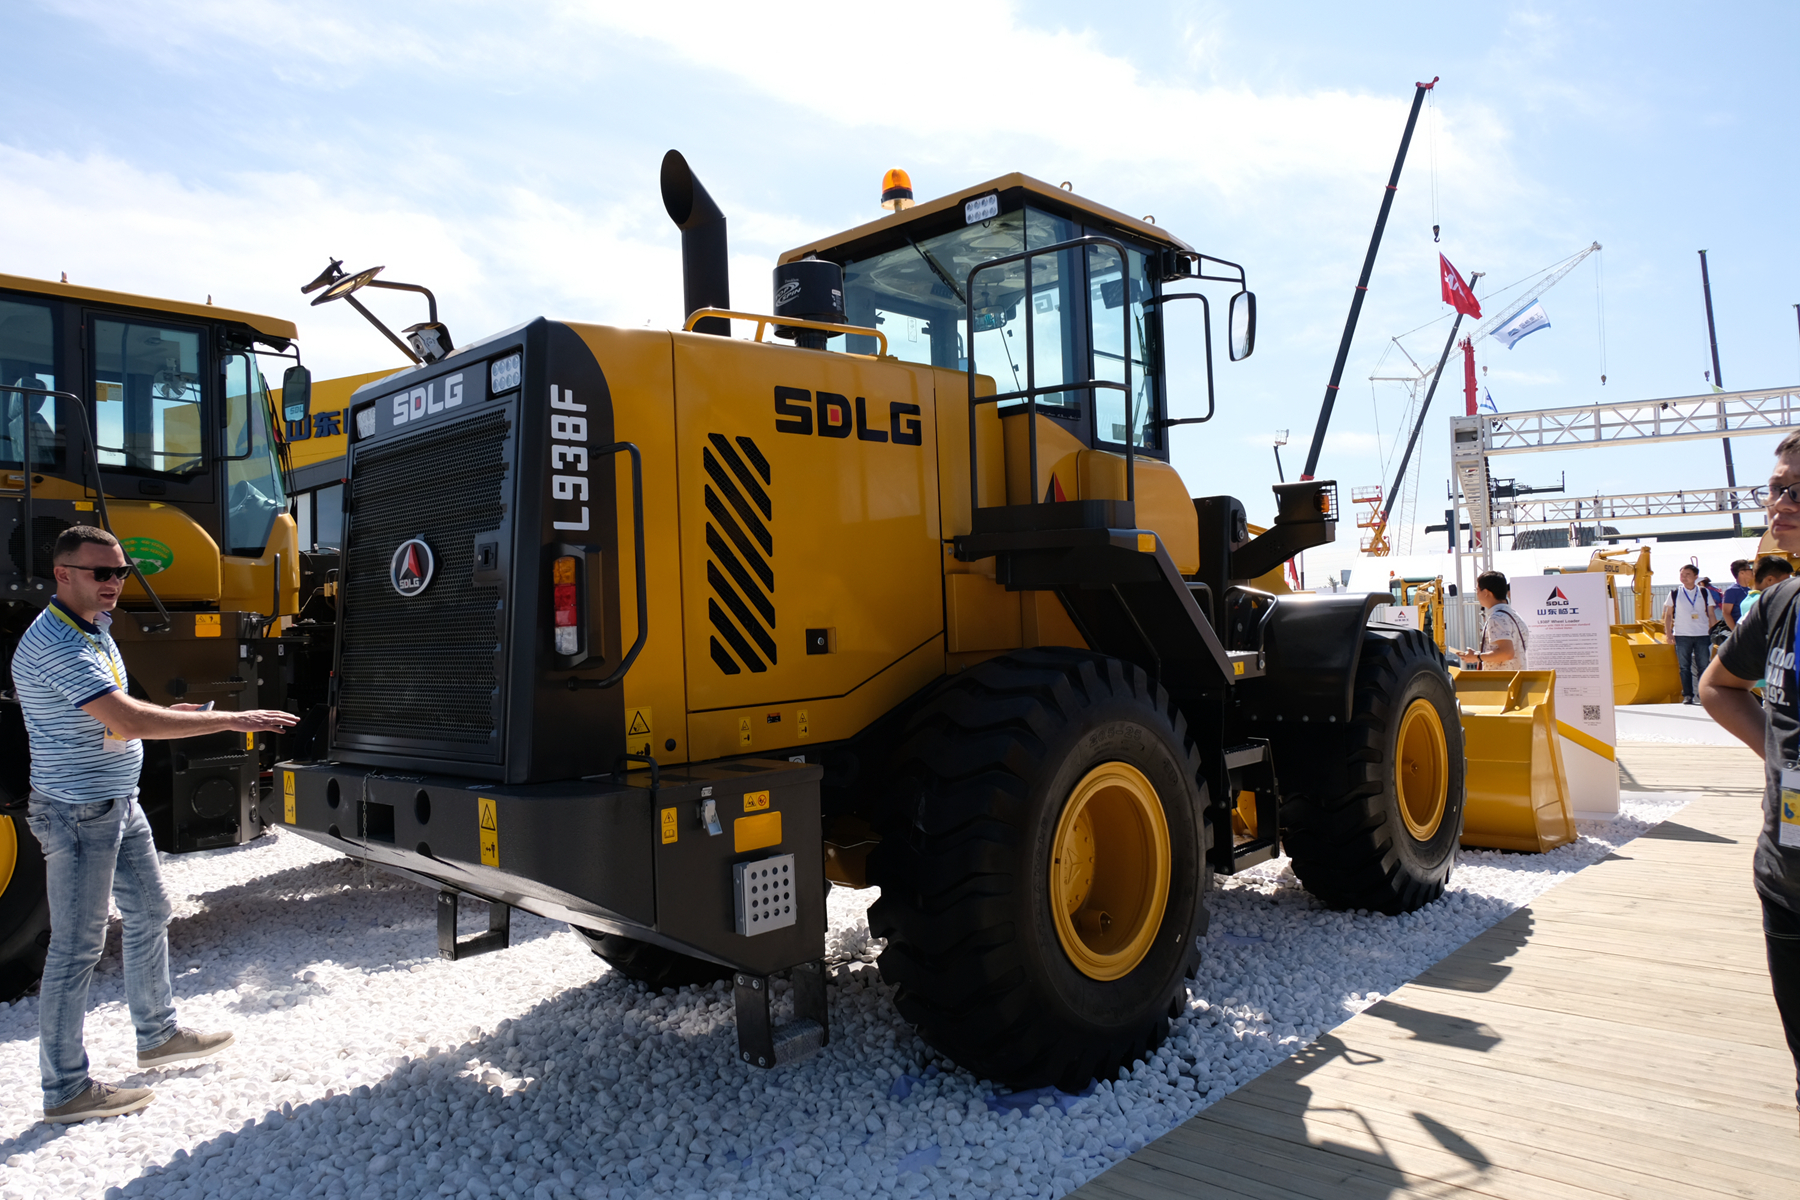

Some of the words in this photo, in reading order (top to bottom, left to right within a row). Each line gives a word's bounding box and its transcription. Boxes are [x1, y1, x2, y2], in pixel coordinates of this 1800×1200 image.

[393, 372, 464, 427] SDLG
[774, 385, 923, 447] SDLG
[285, 408, 349, 442] 山东
[550, 384, 590, 532] L938F
[399, 577, 420, 589] SDLG
[1604, 564, 1620, 573] SDLG
